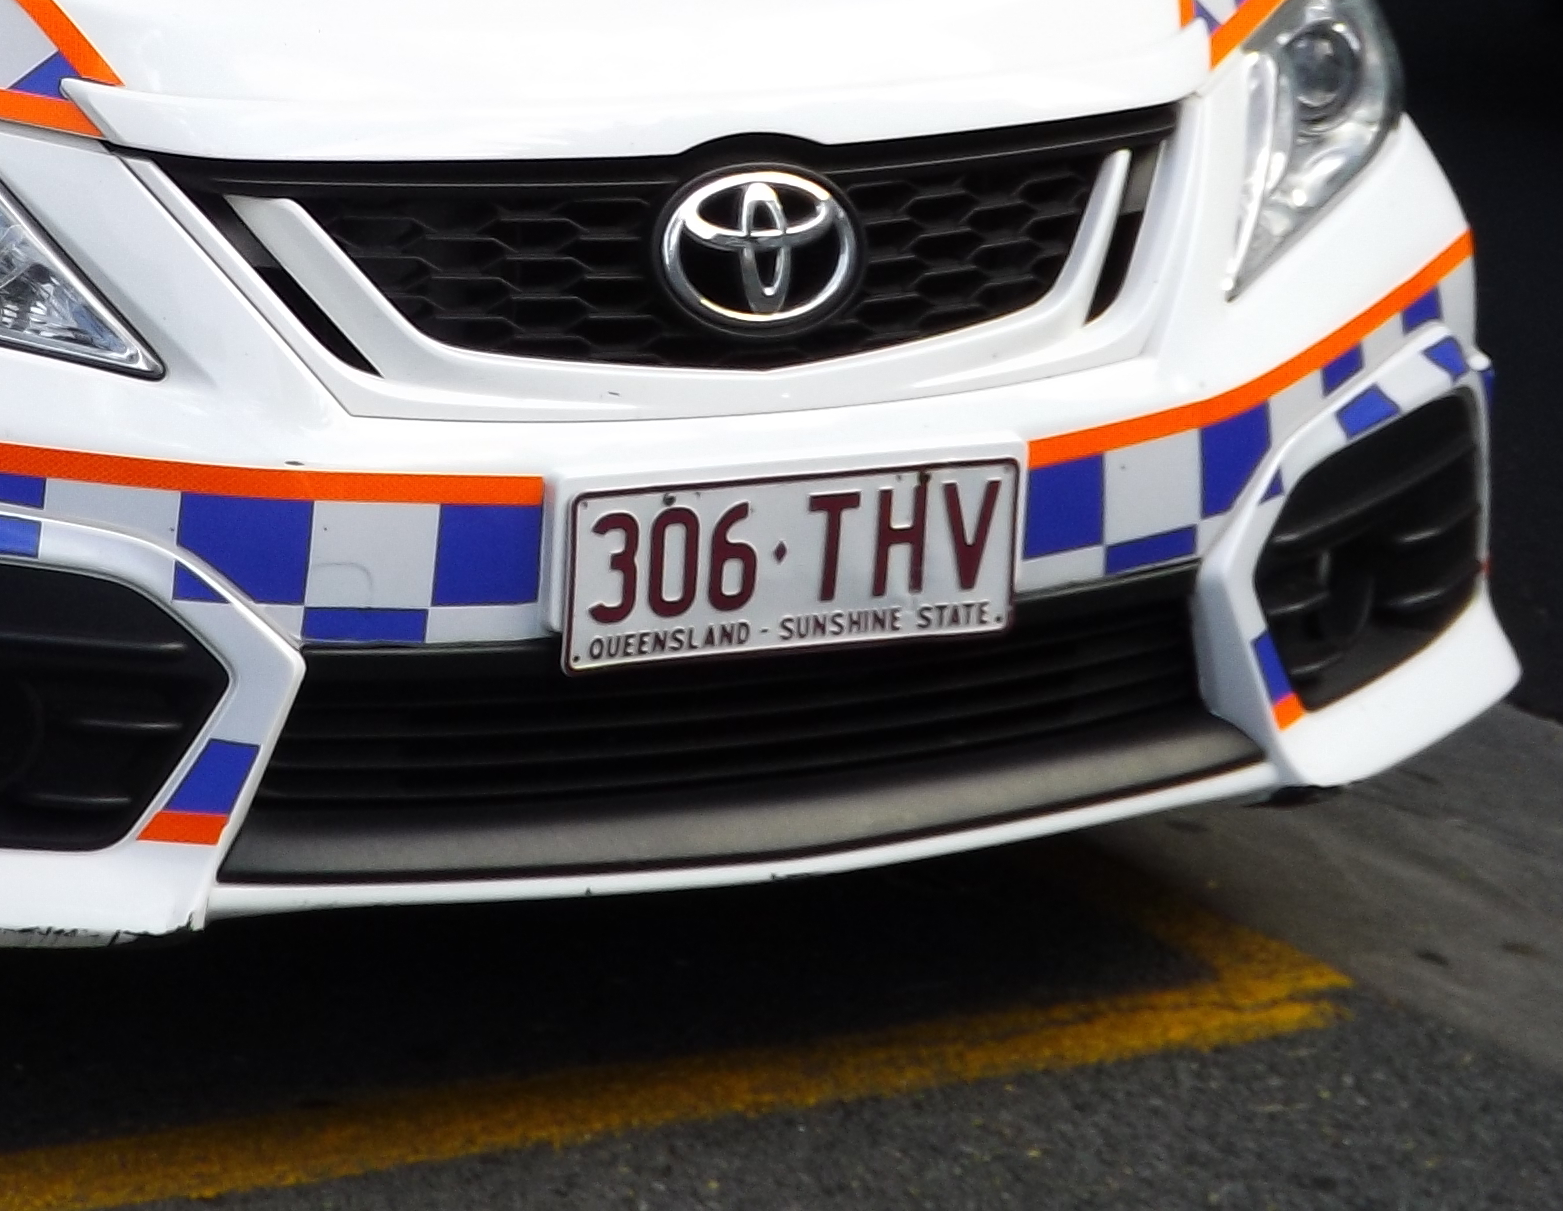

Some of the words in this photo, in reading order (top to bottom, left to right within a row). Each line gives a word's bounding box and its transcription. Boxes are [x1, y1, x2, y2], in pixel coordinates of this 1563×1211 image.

[588, 621, 751, 662] QUEENSLAND
[778, 611, 902, 642] SUNSHINE
[916, 601, 990, 631] STATE
